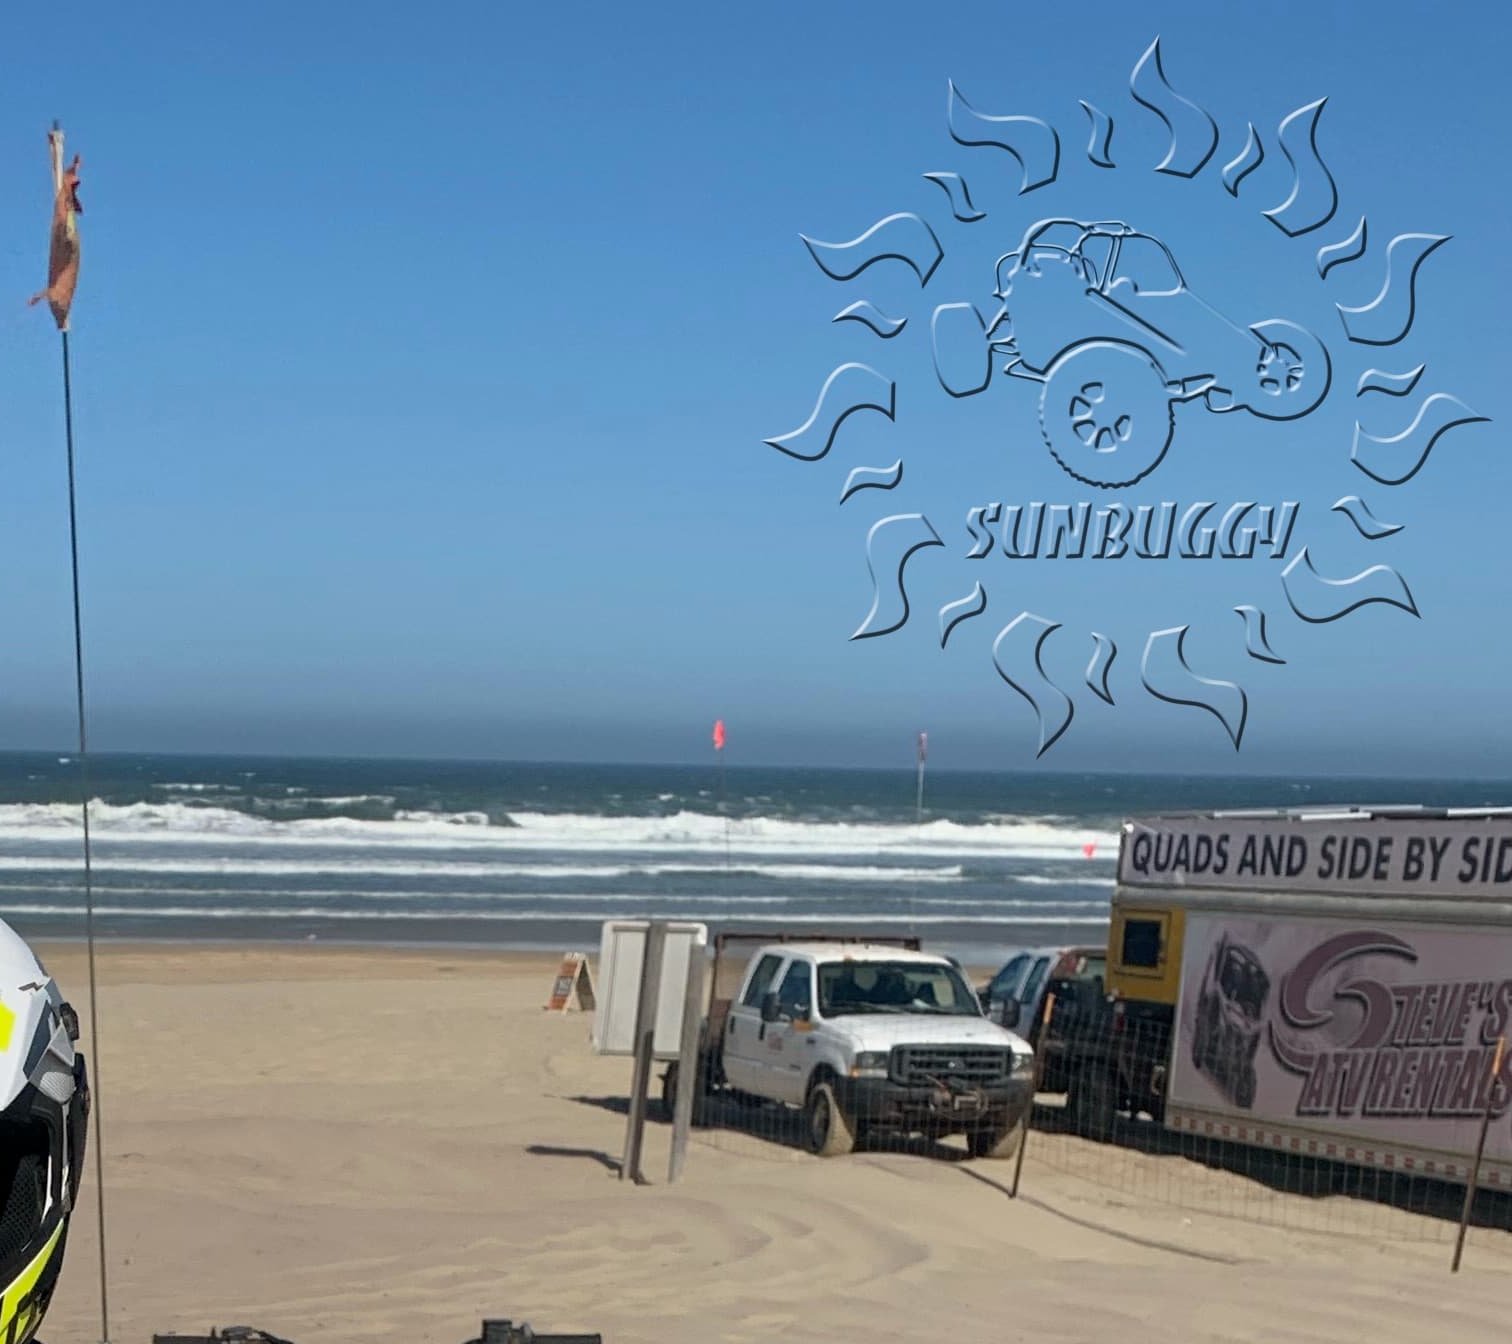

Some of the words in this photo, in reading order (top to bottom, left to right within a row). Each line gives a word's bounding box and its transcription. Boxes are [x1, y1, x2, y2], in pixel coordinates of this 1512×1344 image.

[1132, 832, 1230, 876] QUADS
[1237, 834, 1308, 877] AND
[1317, 835, 1393, 880] SIDE
[1402, 836, 1453, 882] BY
[1296, 1050, 1374, 1117] ATV
